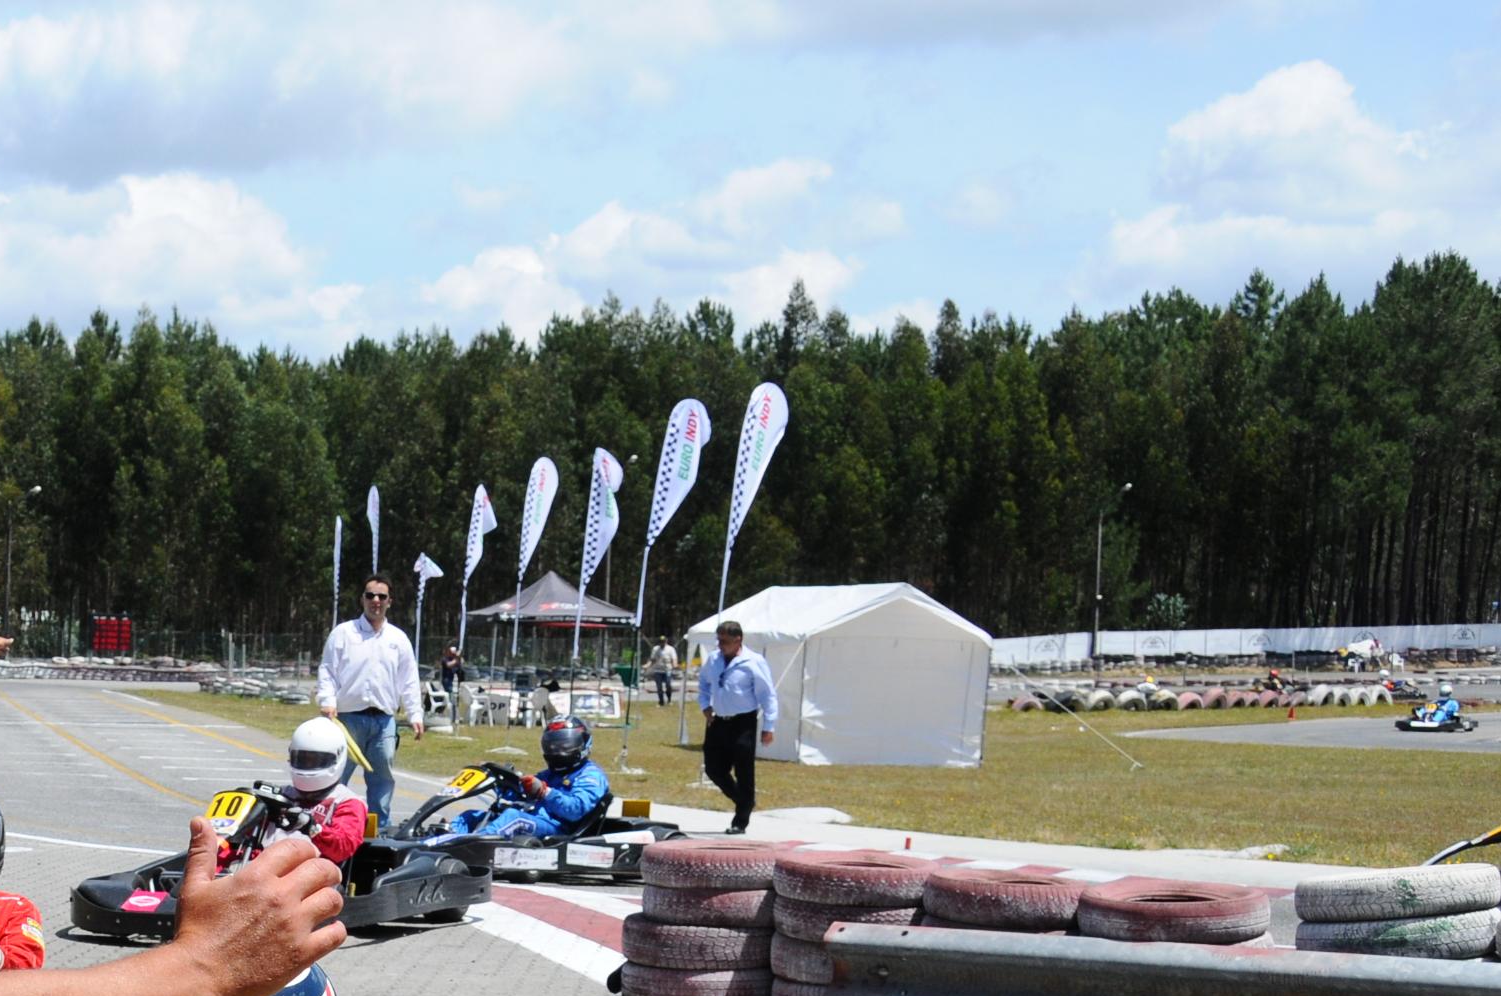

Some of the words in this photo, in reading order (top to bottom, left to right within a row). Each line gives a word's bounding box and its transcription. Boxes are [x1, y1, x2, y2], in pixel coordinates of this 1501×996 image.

[683, 408, 700, 443] INDY
[751, 430, 766, 472] EURO
[759, 392, 773, 430] INDY
[677, 442, 696, 481] EURO
[211, 795, 244, 817] 10
